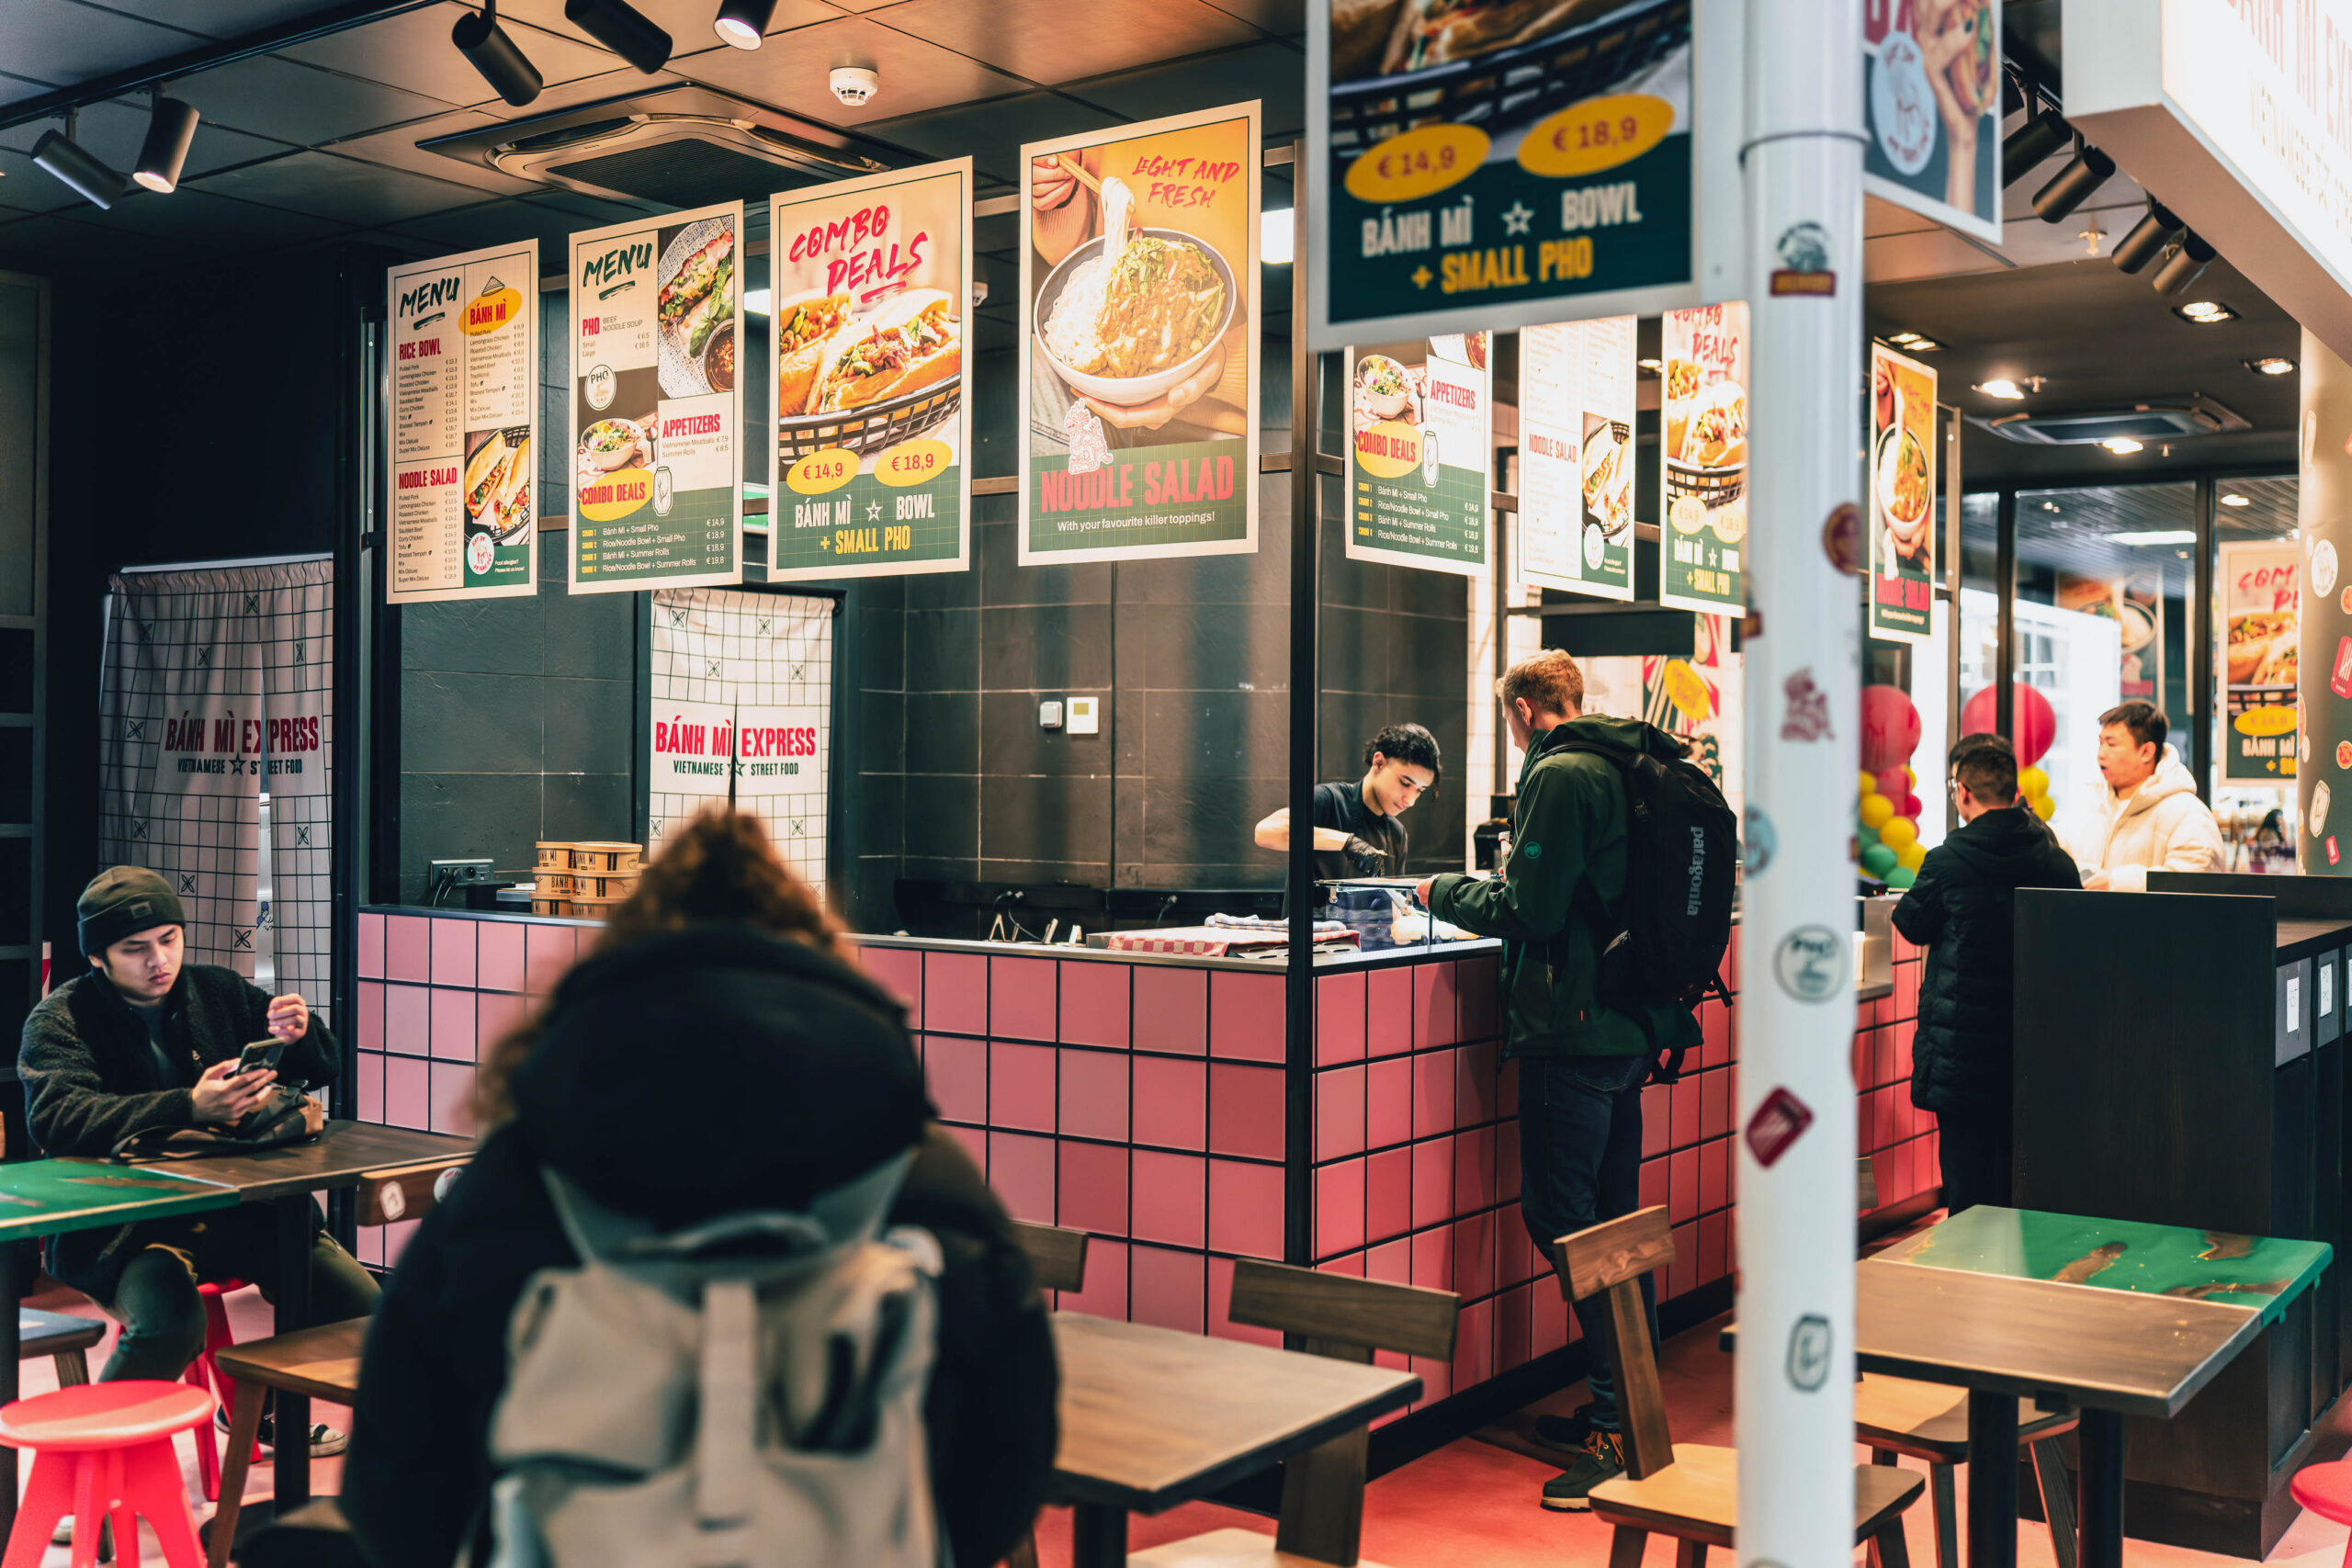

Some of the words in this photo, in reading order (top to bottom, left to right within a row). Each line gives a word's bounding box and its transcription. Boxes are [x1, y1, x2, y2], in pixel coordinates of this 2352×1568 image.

[1553, 126, 1568, 152] €
[1576, 117, 1637, 151] 18,9
[1132, 154, 1195, 178] LIGHT
[1193, 160, 1240, 184] AND
[1376, 153, 1393, 178] €
[1400, 144, 1455, 176] 14,9
[1148, 182, 1216, 209] FRESH
[789, 205, 890, 263] COMBO
[1362, 207, 1431, 257] BÁNH
[1441, 195, 1475, 248] MÌ
[1562, 181, 1642, 231] BOWL
[583, 243, 652, 288] MENU
[827, 231, 928, 298] DEALS
[1411, 265, 1433, 288] +
[1441, 244, 1530, 294] SMALL
[1538, 236, 1593, 282] PHO
[400, 277, 459, 318] MENU
[470, 302, 493, 325] BÁNH
[496, 298, 507, 321] MÌ
[582, 316, 600, 337] PHO
[603, 316, 617, 324] BEEF
[603, 322, 626, 332] NOODLE
[627, 320, 643, 328] SOUP
[399, 342, 416, 361] RICE
[419, 337, 442, 357] BOWL
[1692, 333, 1737, 367] DEALS
[1430, 378, 1476, 411] APPETIZERS
[662, 413, 720, 438] APPETIZERS
[1358, 430, 1387, 457] COMBO
[1390, 438, 1416, 463] DEALS
[1529, 433, 1553, 457] NOODLE
[1555, 440, 1577, 463] SALAD
[803, 465, 811, 479] €
[814, 462, 843, 480] 14,9
[891, 457, 900, 471] €
[903, 453, 934, 472] 18,9
[399, 470, 427, 490] NOODLE
[430, 467, 458, 486] SALAD
[582, 485, 613, 505] COMBO
[616, 481, 646, 502] DEALS
[1041, 464, 1133, 513] NOODLE
[1144, 456, 1234, 506] SALAD
[795, 498, 831, 528] BÁNH
[835, 494, 853, 525] MÌ
[896, 493, 935, 521] BOWL
[1057, 520, 1079, 532] With
[1080, 520, 1101, 533] your
[1102, 514, 1143, 529] favourite
[1144, 513, 1168, 526] killer
[1169, 511, 1216, 525] toppings!
[603, 526, 617, 536] Bánh
[630, 525, 647, 533] Small
[647, 524, 660, 532] Pho
[637, 536, 651, 545] Bowl
[656, 534, 673, 544] Small
[673, 534, 686, 542] Pho
[820, 536, 831, 550] +
[835, 527, 879, 555] SMALL
[884, 525, 911, 551] PHO
[603, 551, 617, 560] Bánh
[630, 549, 655, 558] Summer
[655, 547, 670, 556] Rolls
[637, 561, 651, 570] Bowl
[656, 560, 681, 569] Summer
[681, 558, 696, 566] Rolls
[164, 710, 206, 751] BÁNH
[213, 710, 235, 752] MÌ
[655, 715, 705, 755] BÁNH
[712, 718, 732, 757] MÌ
[741, 727, 816, 757] EXPRESS
[177, 758, 226, 774] VIETNAMESE
[250, 759, 284, 775] SEET
[285, 758, 303, 774] FOOD
[673, 760, 724, 776] VIETNAMESE
[751, 762, 778, 776] STREET
[780, 762, 799, 775] FOOD
[1686, 826, 1706, 917] patagonia
